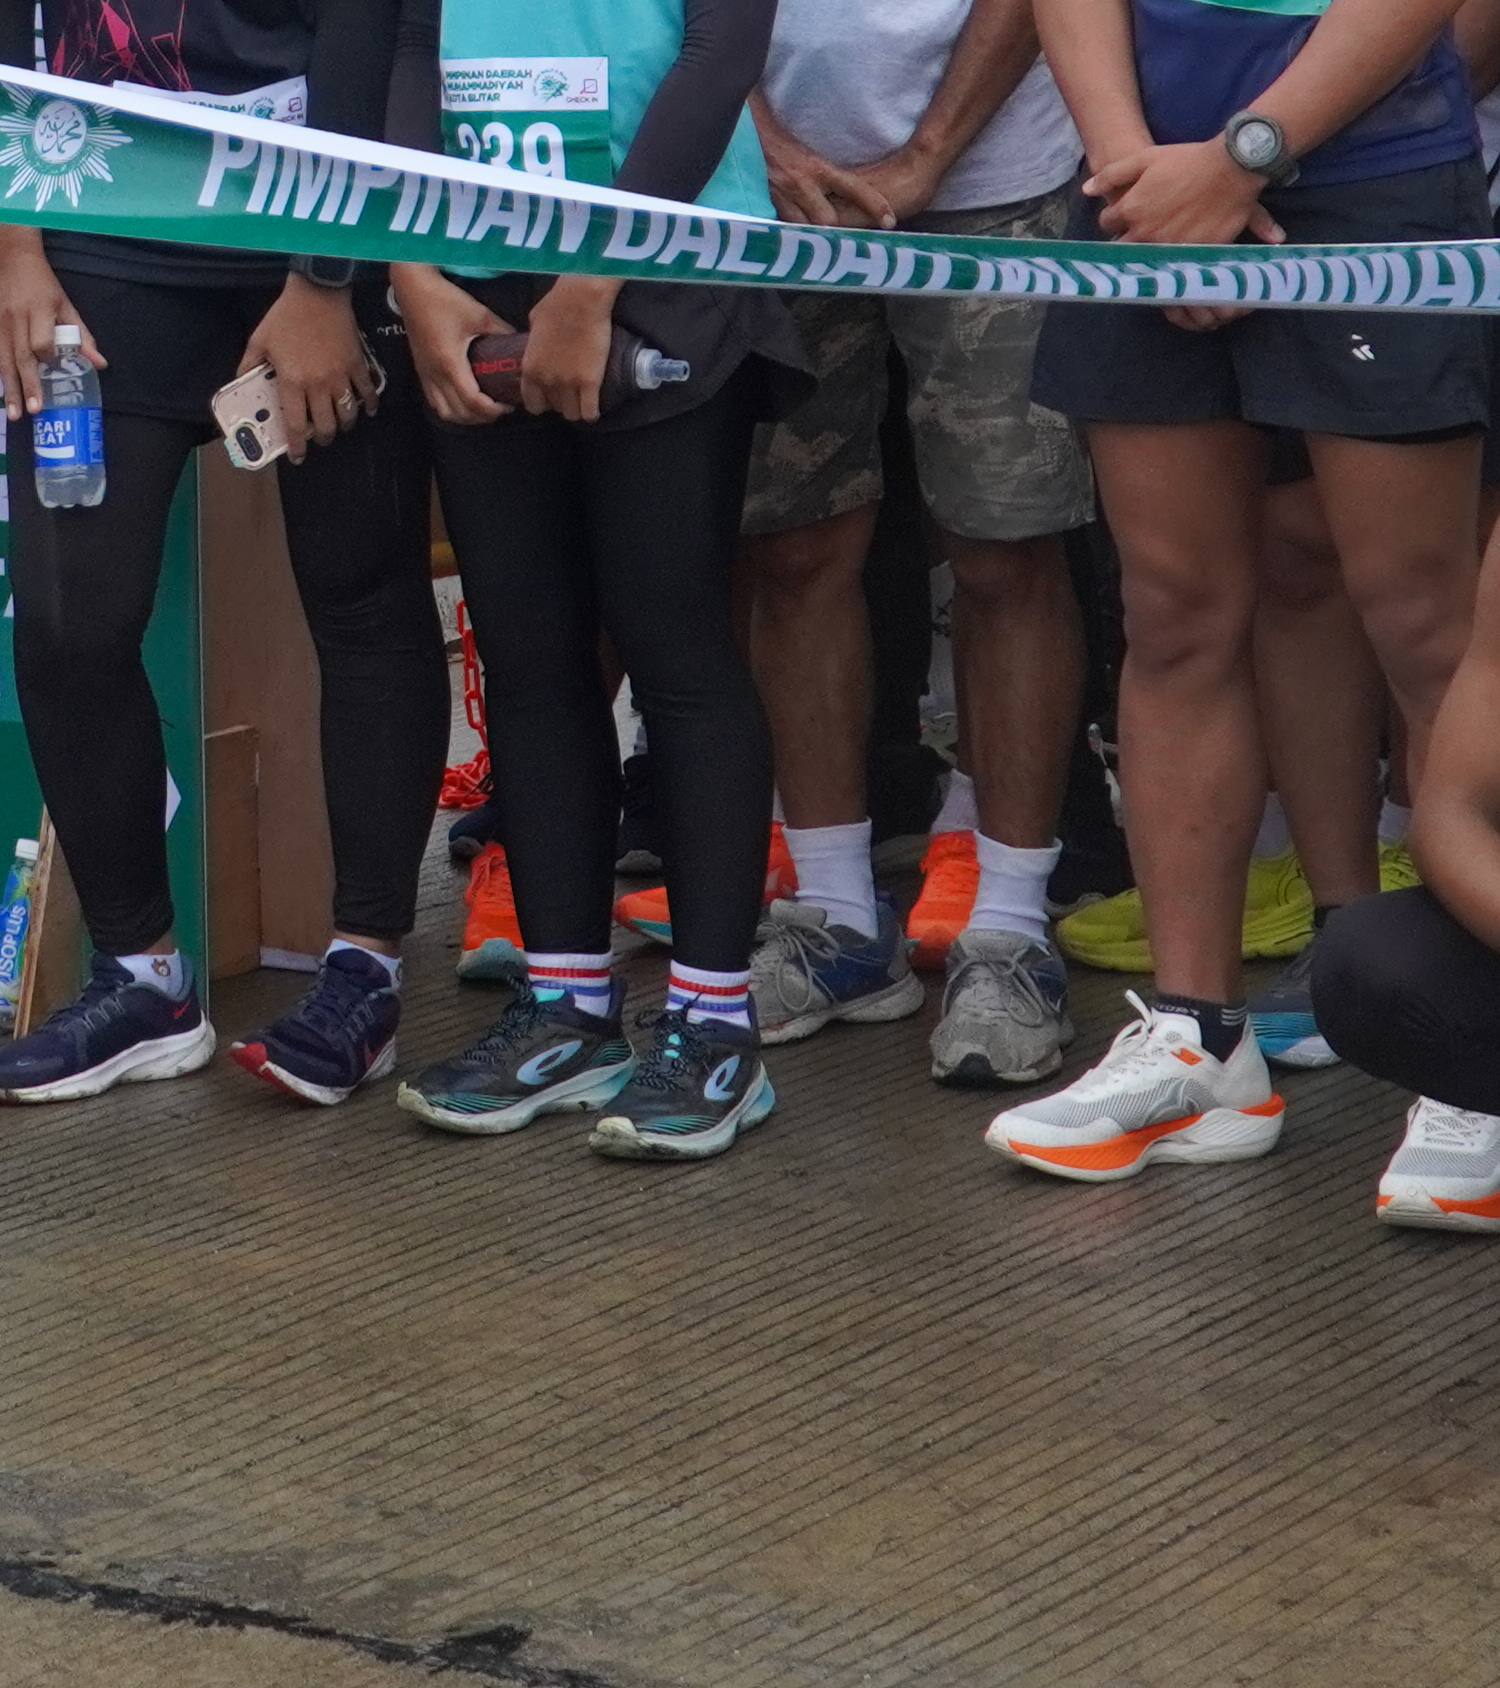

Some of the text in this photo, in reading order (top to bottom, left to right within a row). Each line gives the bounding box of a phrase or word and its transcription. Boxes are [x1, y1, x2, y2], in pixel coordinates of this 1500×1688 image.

[486, 69, 533, 79] DAERAH
[197, 129, 597, 255] PIMPINAN
[33, 419, 72, 434] CARI
